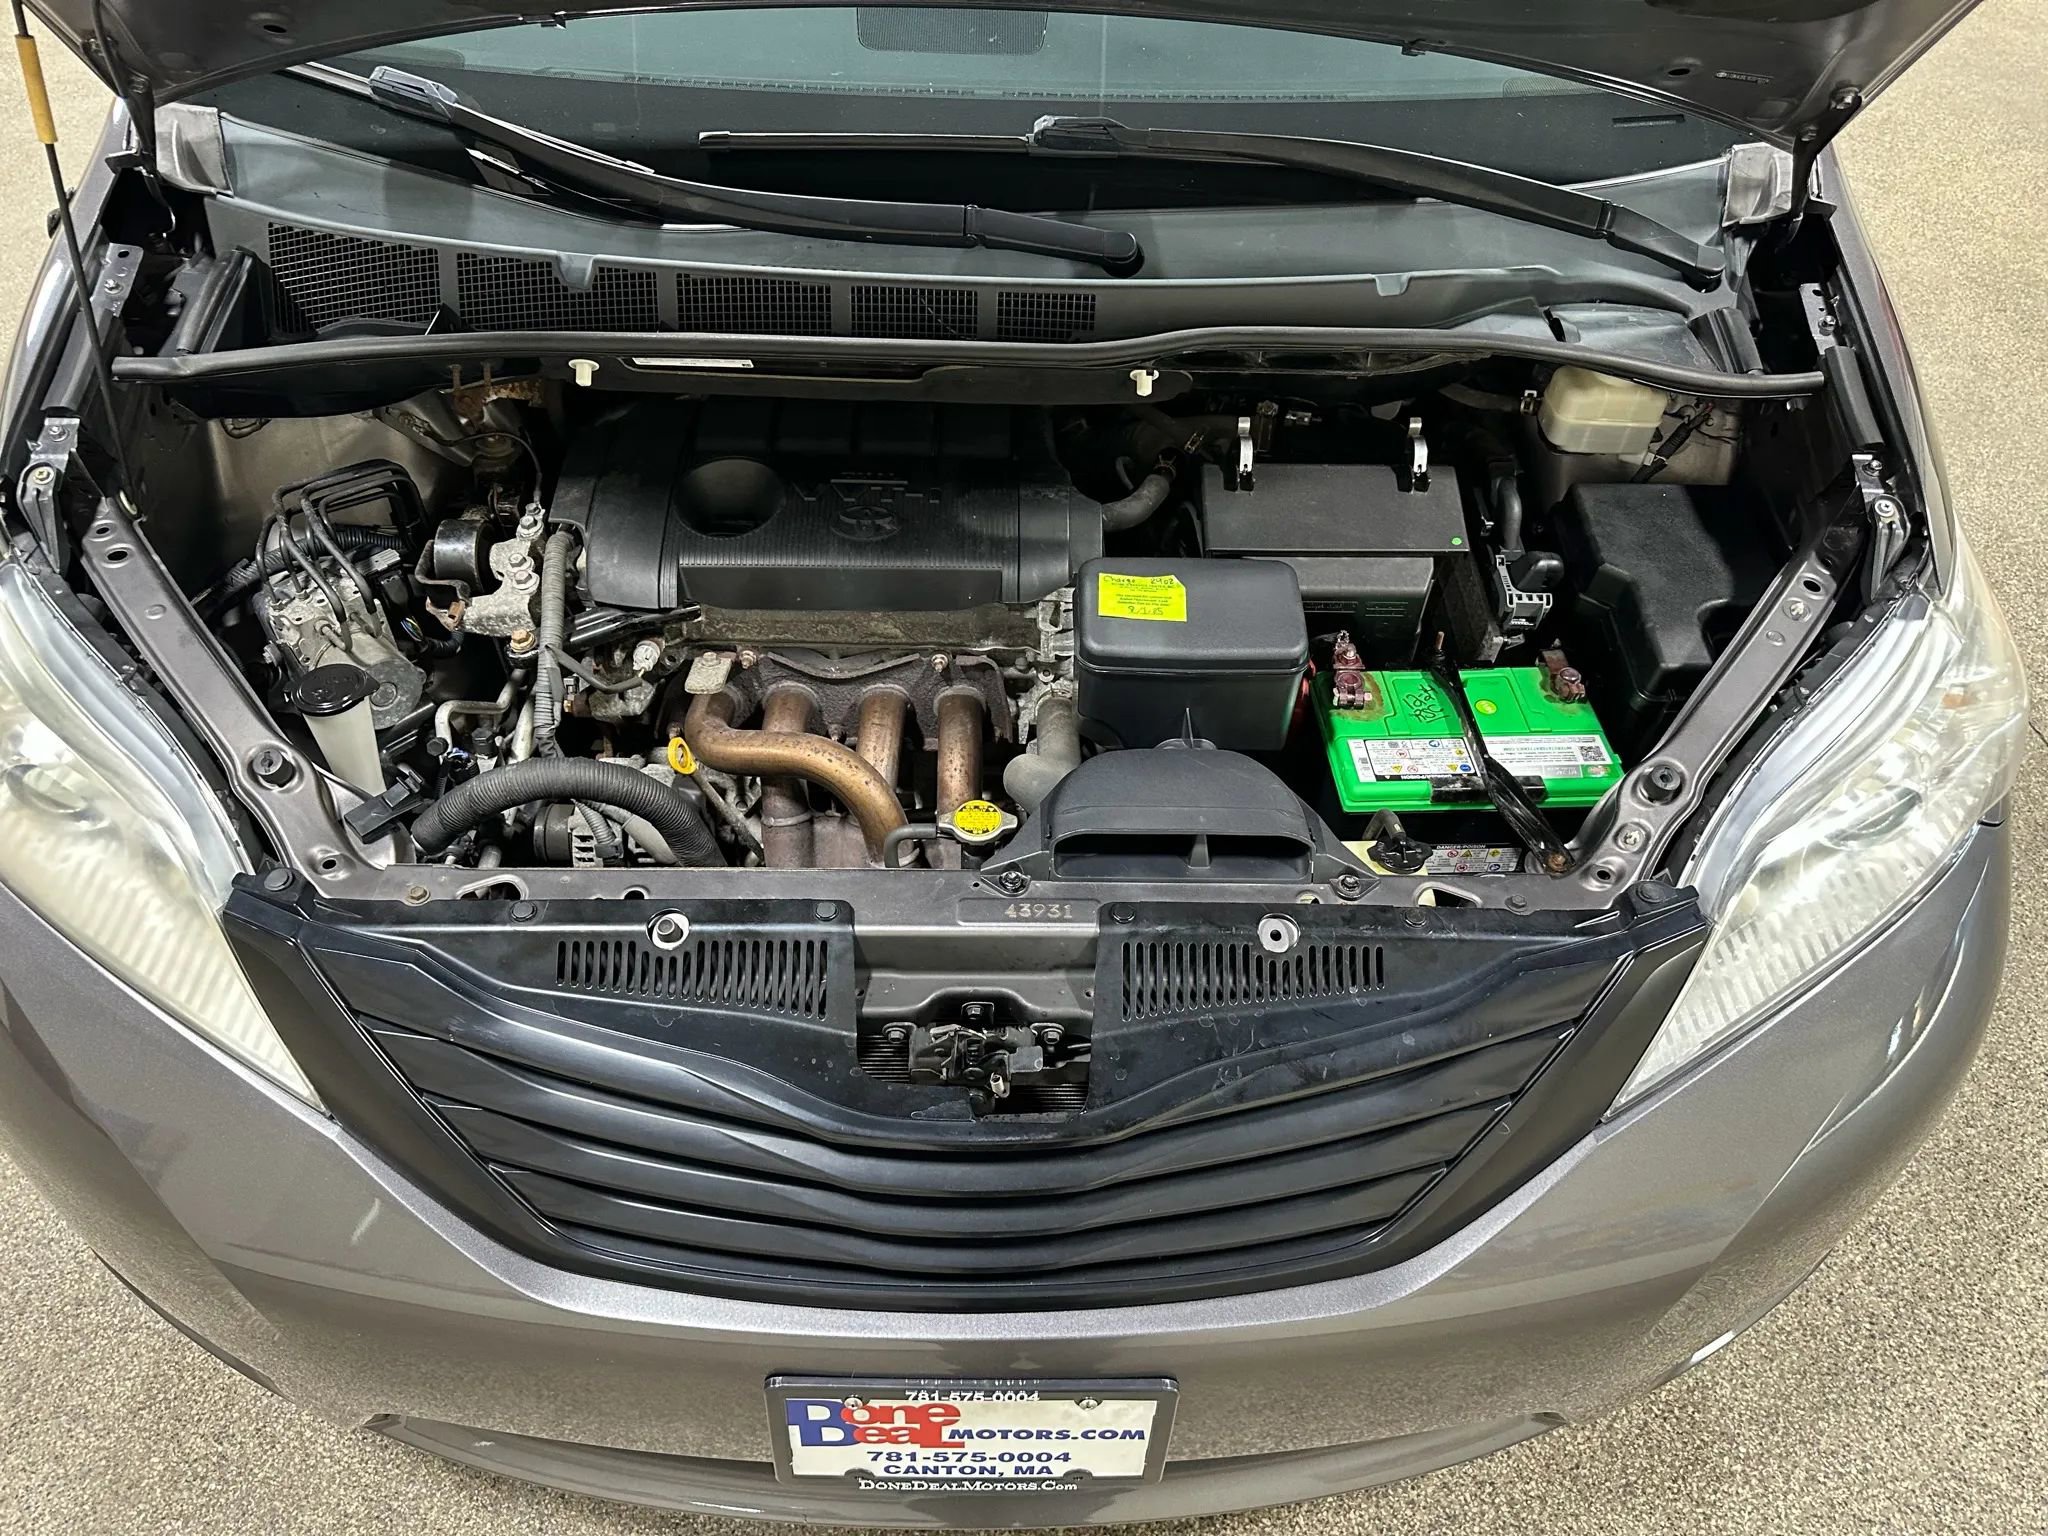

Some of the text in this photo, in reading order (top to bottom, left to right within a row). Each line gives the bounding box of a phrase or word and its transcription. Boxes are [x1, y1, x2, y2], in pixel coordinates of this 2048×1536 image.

[1004, 903, 1073, 918] 43931
[905, 1390, 1040, 1401] 781-575-0004
[948, 1428, 1145, 1441] MOTORS.COM
[867, 1451, 1072, 1462] 781-575-0004
[883, 1465, 1054, 1477] CANTON, MA
